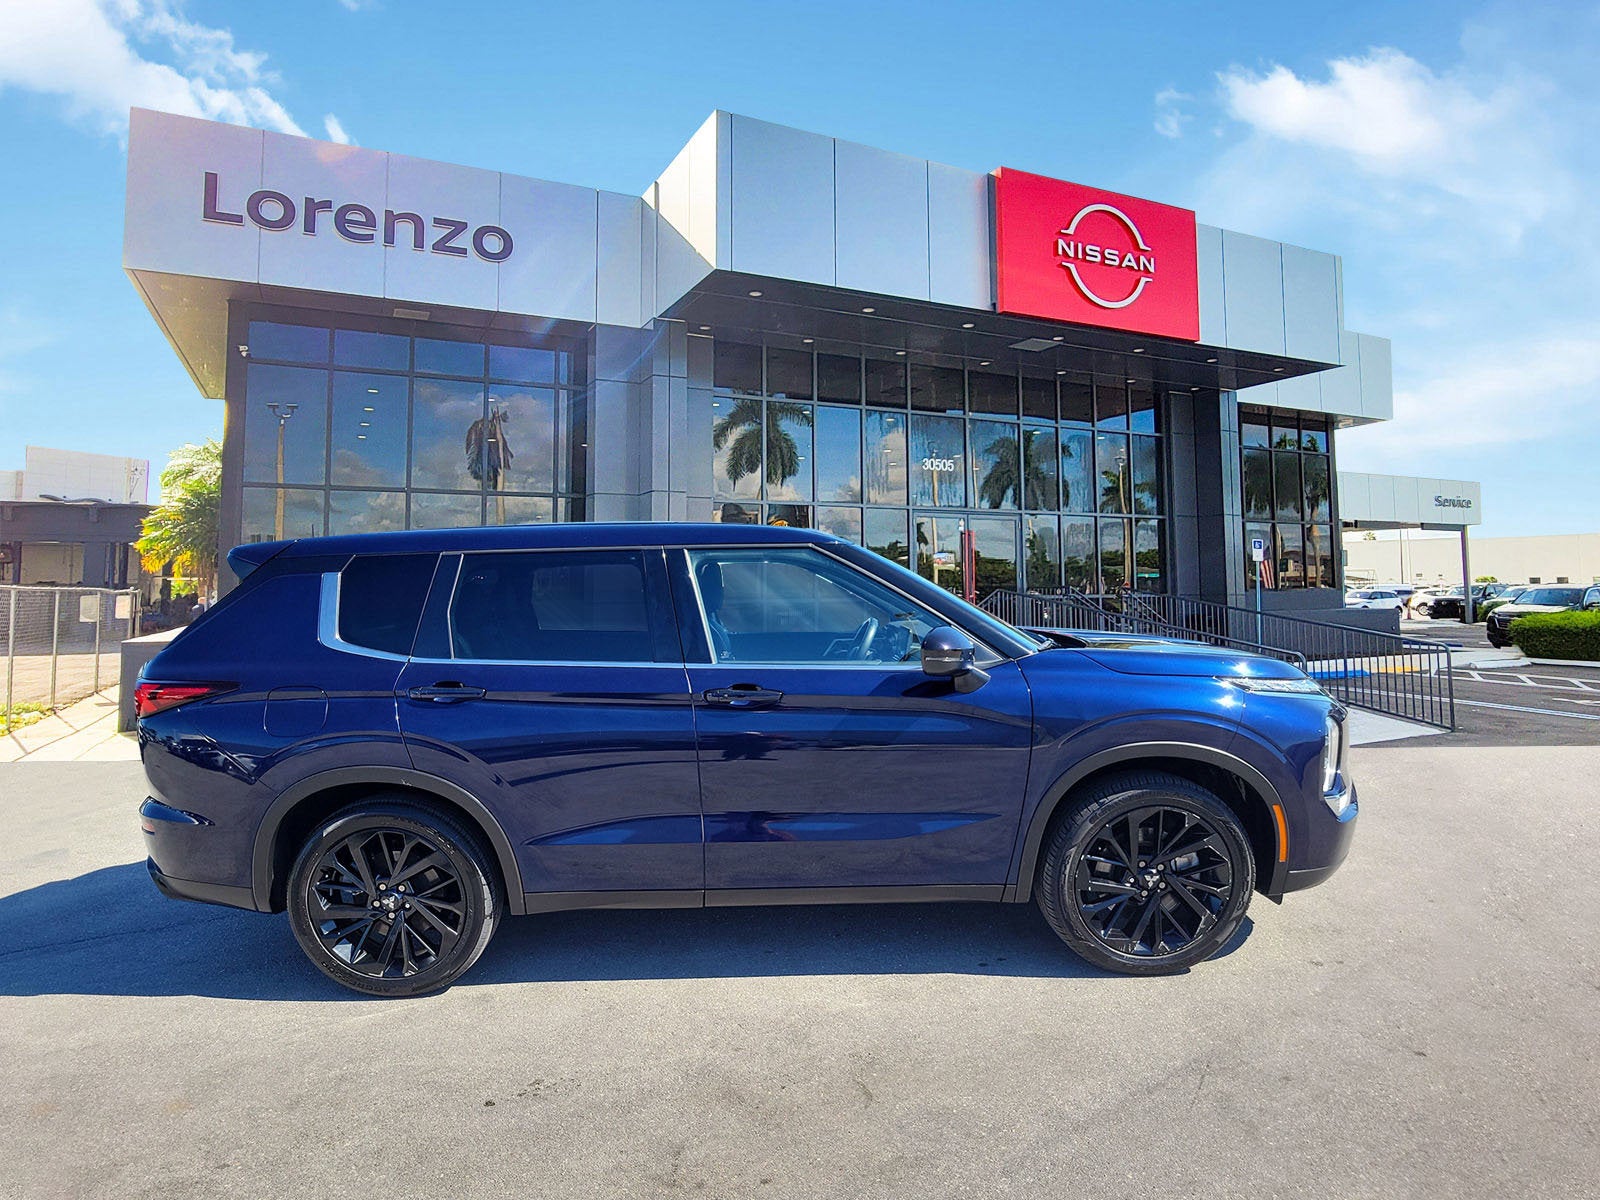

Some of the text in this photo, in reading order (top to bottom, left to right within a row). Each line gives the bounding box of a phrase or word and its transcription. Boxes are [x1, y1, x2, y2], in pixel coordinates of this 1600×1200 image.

[203, 171, 514, 263] Lorenzo
[1057, 238, 1155, 274] NISSAN
[922, 457, 955, 471] 30505
[1434, 495, 1472, 509] Service
